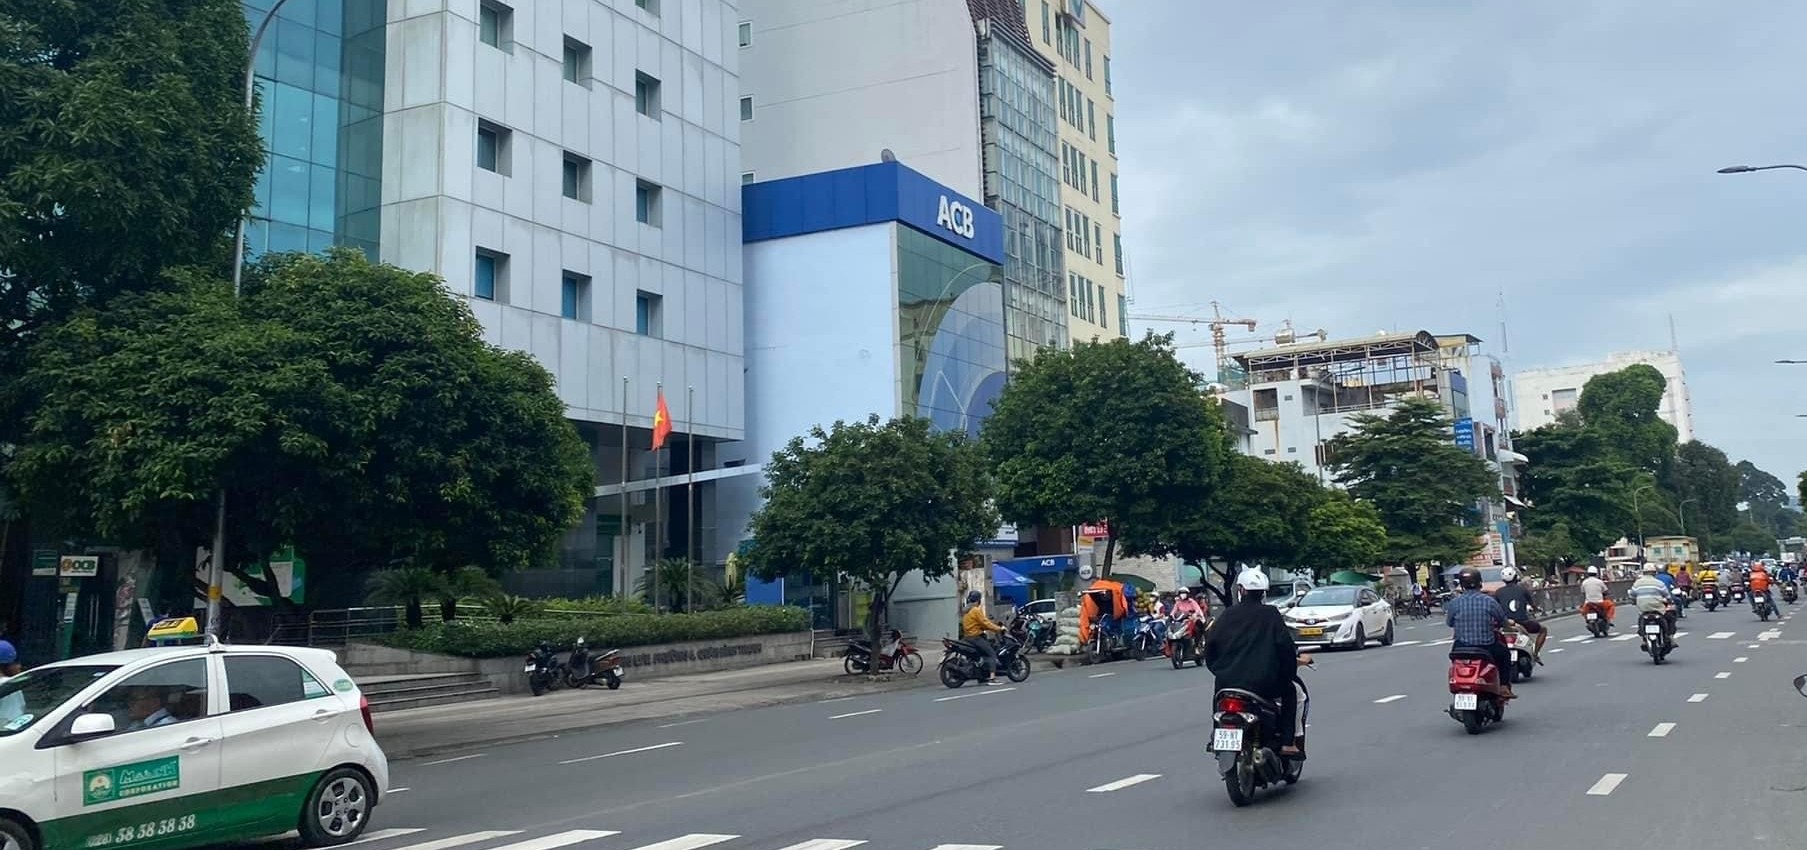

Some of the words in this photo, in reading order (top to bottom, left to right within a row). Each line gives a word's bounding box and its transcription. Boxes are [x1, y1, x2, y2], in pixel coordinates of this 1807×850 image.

[937, 195, 975, 239] ACB
[72, 560, 97, 570] OCB
[1040, 558, 1056, 567] ACB
[119, 779, 179, 797] CORPORATION
[115, 826, 135, 844] 38
[137, 821, 156, 840] 38
[158, 817, 176, 835] 38
[178, 813, 196, 832] 38
